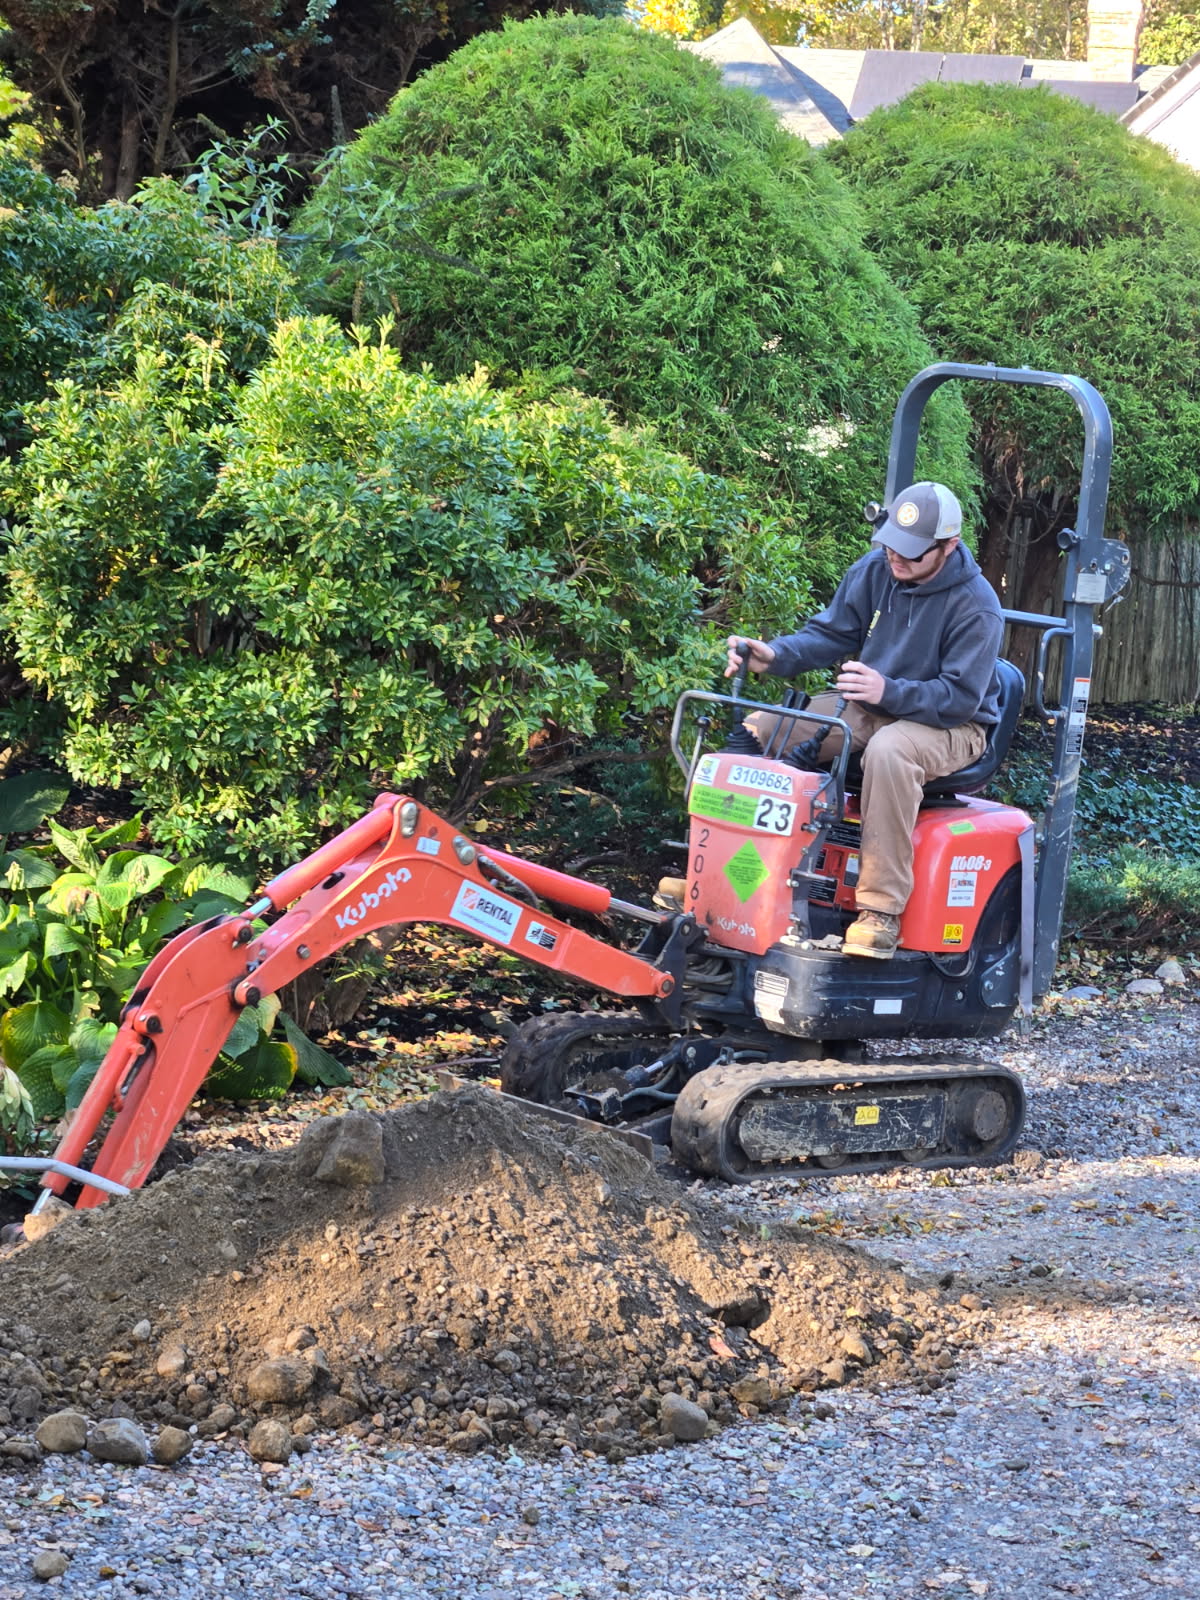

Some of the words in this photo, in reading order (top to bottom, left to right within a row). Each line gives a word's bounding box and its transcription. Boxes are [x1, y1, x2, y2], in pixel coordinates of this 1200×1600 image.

[733, 767, 792, 791] 3109682
[757, 798, 792, 832] 23
[690, 828, 710, 912] 206
[335, 867, 412, 929] Kubota
[476, 897, 513, 926] RENTAL
[717, 916, 757, 937] Kubota
